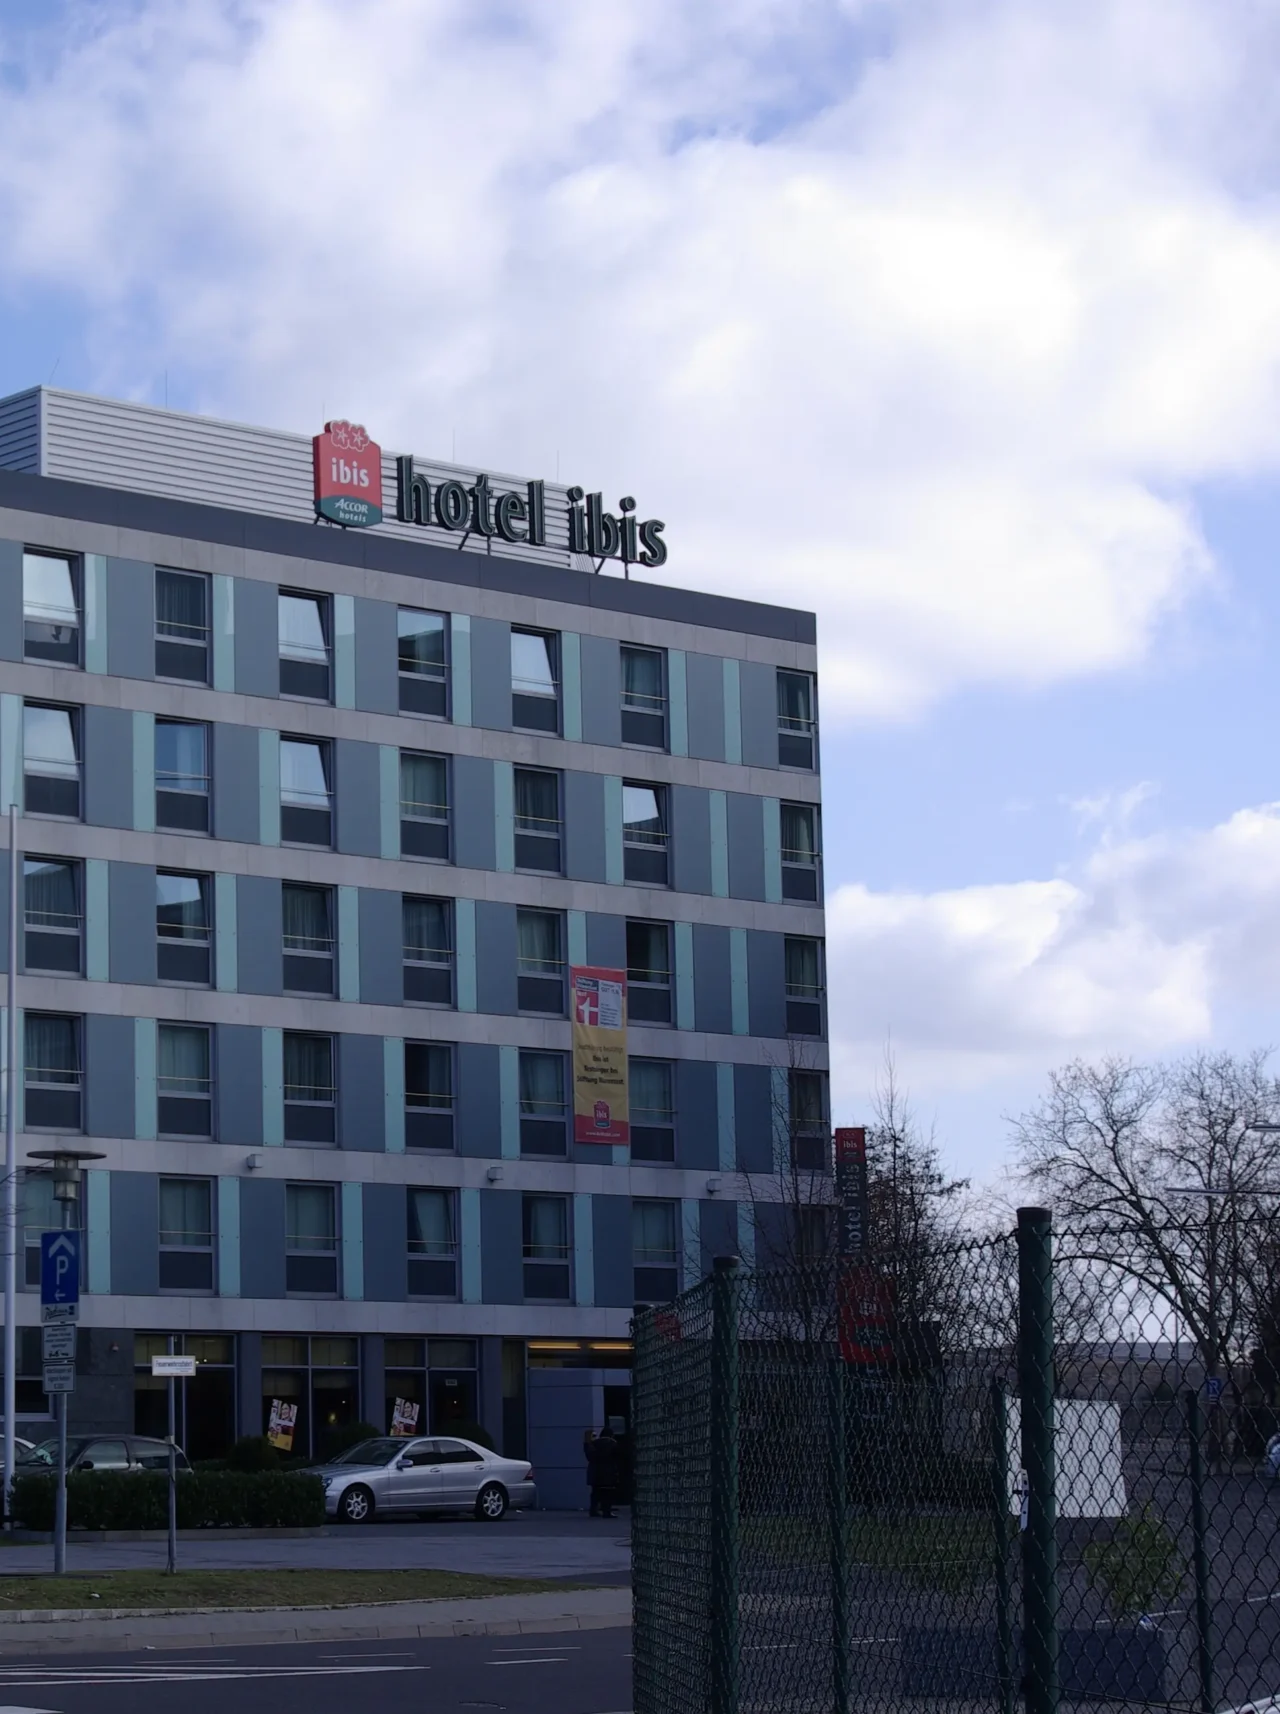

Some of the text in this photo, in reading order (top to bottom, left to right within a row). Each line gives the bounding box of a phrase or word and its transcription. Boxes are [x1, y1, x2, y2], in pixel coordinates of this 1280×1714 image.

[331, 457, 369, 488] ibis
[334, 498, 369, 515] ACCOR
[339, 510, 367, 523] hotels
[396, 455, 668, 568] hotel ibis
[843, 1139, 858, 1149] ibis
[842, 1162, 861, 1198] ibis
[844, 1204, 861, 1255] hotel
[56, 1256, 69, 1285] P
